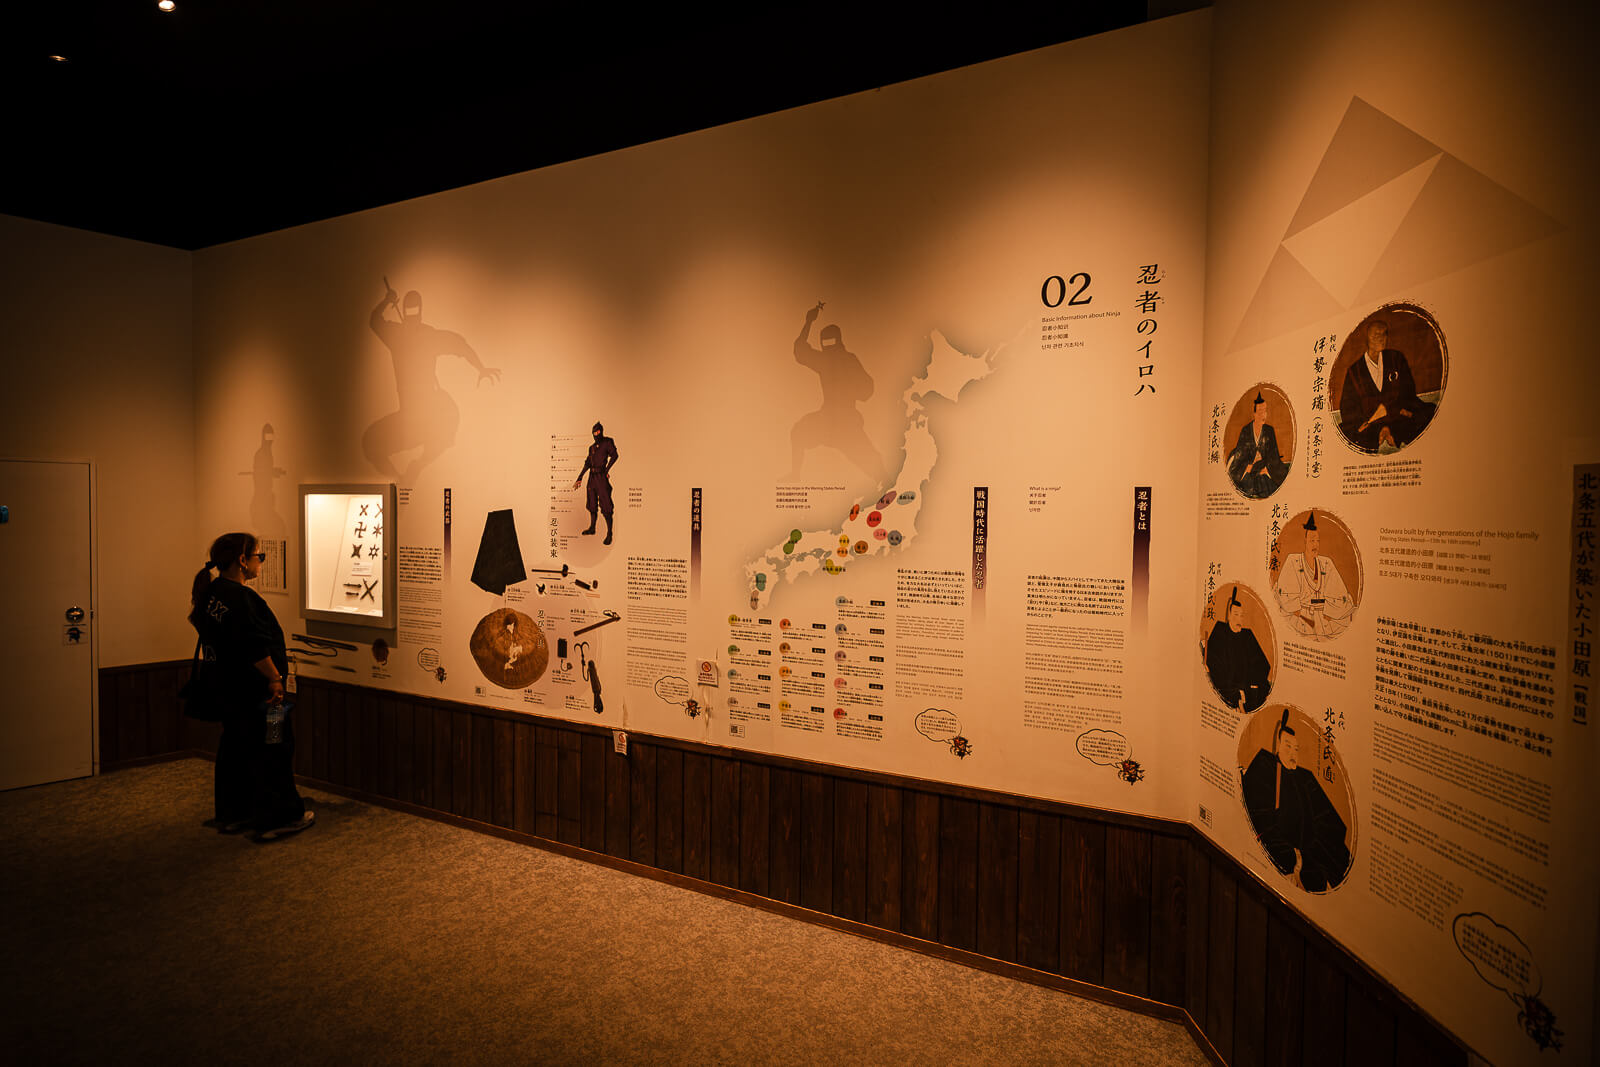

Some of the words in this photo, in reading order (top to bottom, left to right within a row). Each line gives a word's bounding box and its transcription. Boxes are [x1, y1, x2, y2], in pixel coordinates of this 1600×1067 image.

[1041, 272, 1093, 308] 02
[1134, 264, 1161, 396] 忍者のイロハ
[1137, 490, 1148, 530] 忍者とは
[1418, 528, 1424, 536] by
[1438, 530, 1474, 538] generations
[1497, 531, 1514, 539] Hojo
[1516, 531, 1539, 541] family
